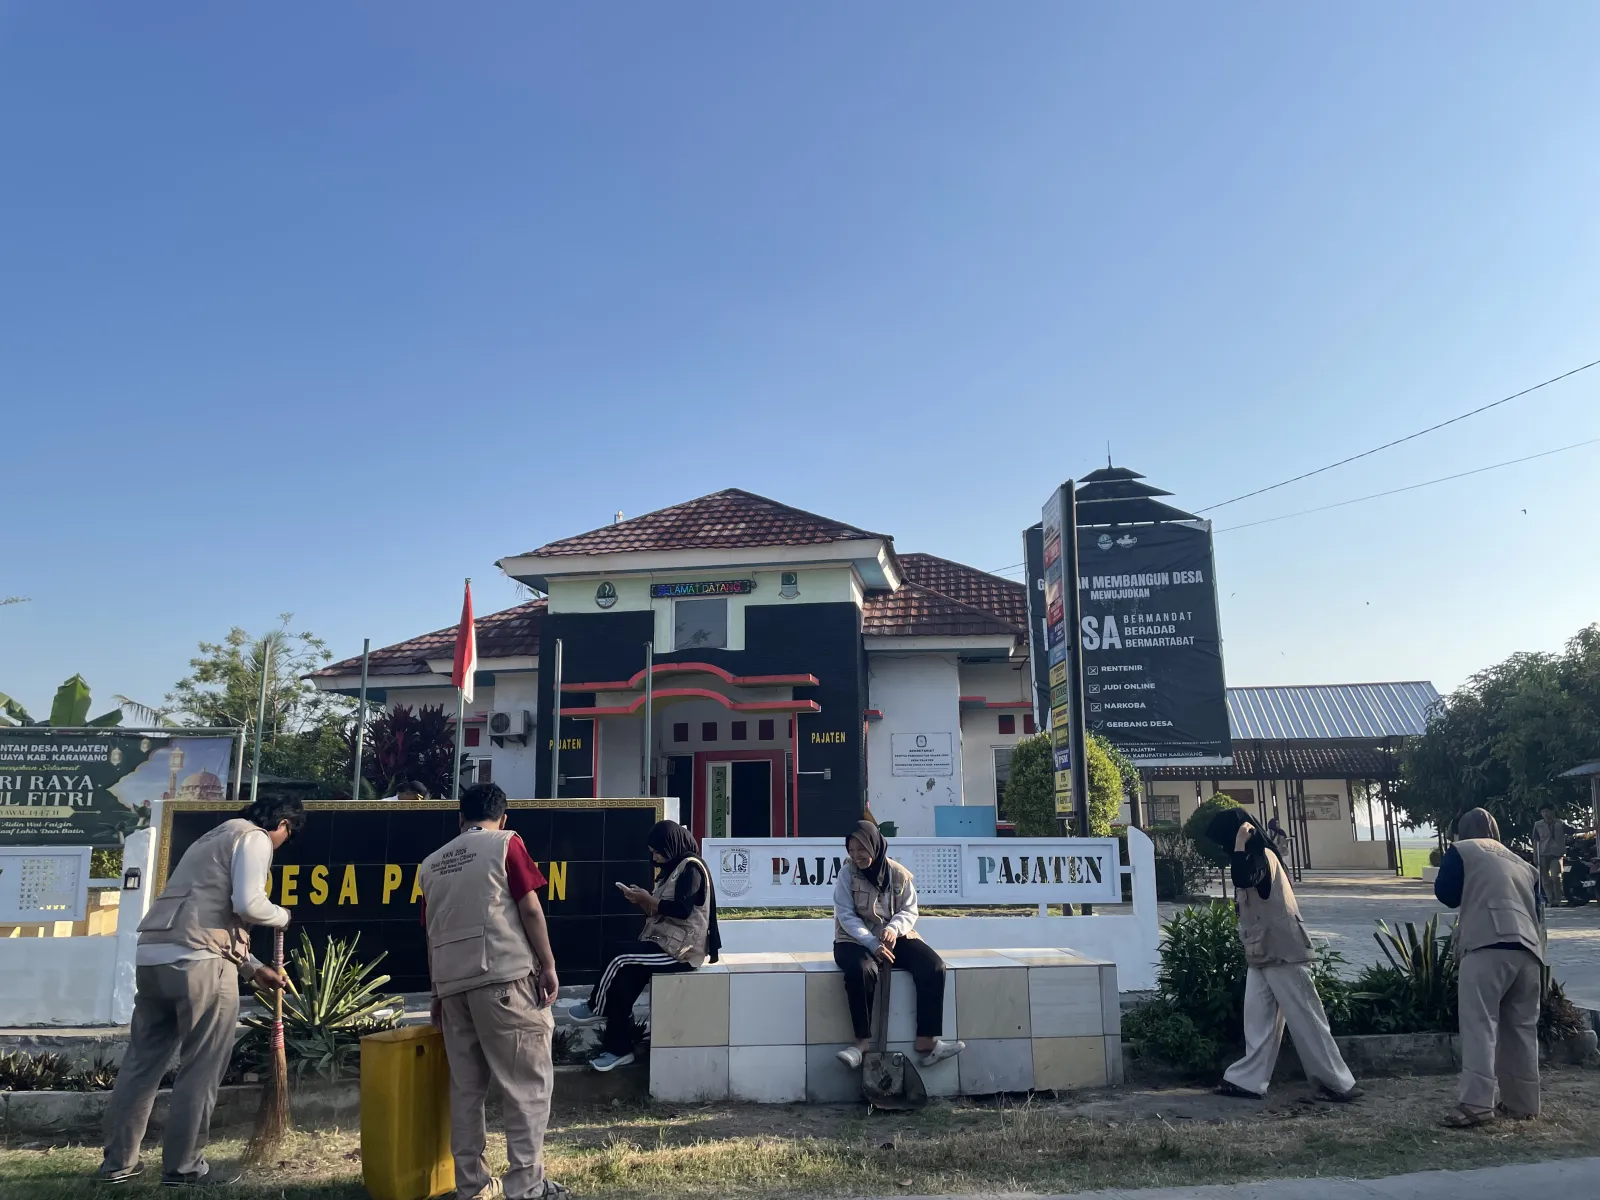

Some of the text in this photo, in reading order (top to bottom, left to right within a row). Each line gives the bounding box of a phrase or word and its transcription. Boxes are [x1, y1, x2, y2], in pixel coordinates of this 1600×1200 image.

[1093, 573, 1169, 589] MEMBANGUN
[1173, 570, 1204, 584] DESA
[658, 581, 741, 596] SELAMAT DATANG
[1091, 588, 1150, 600] MEWUJUDKAN
[1124, 612, 1192, 624] BERMANDAT
[1124, 625, 1176, 636] BERADAB
[1125, 636, 1195, 648] BERMARTABAT
[548, 738, 582, 750] PJATEN
[811, 731, 846, 744] PAJATEN
[30, 744, 59, 752] DESA
[61, 744, 108, 753] PAJATEN
[30, 775, 94, 790] RAYA
[27, 792, 94, 806] FITRI
[771, 857, 842, 886] PAJA
[977, 856, 1103, 884] PAJATEN
